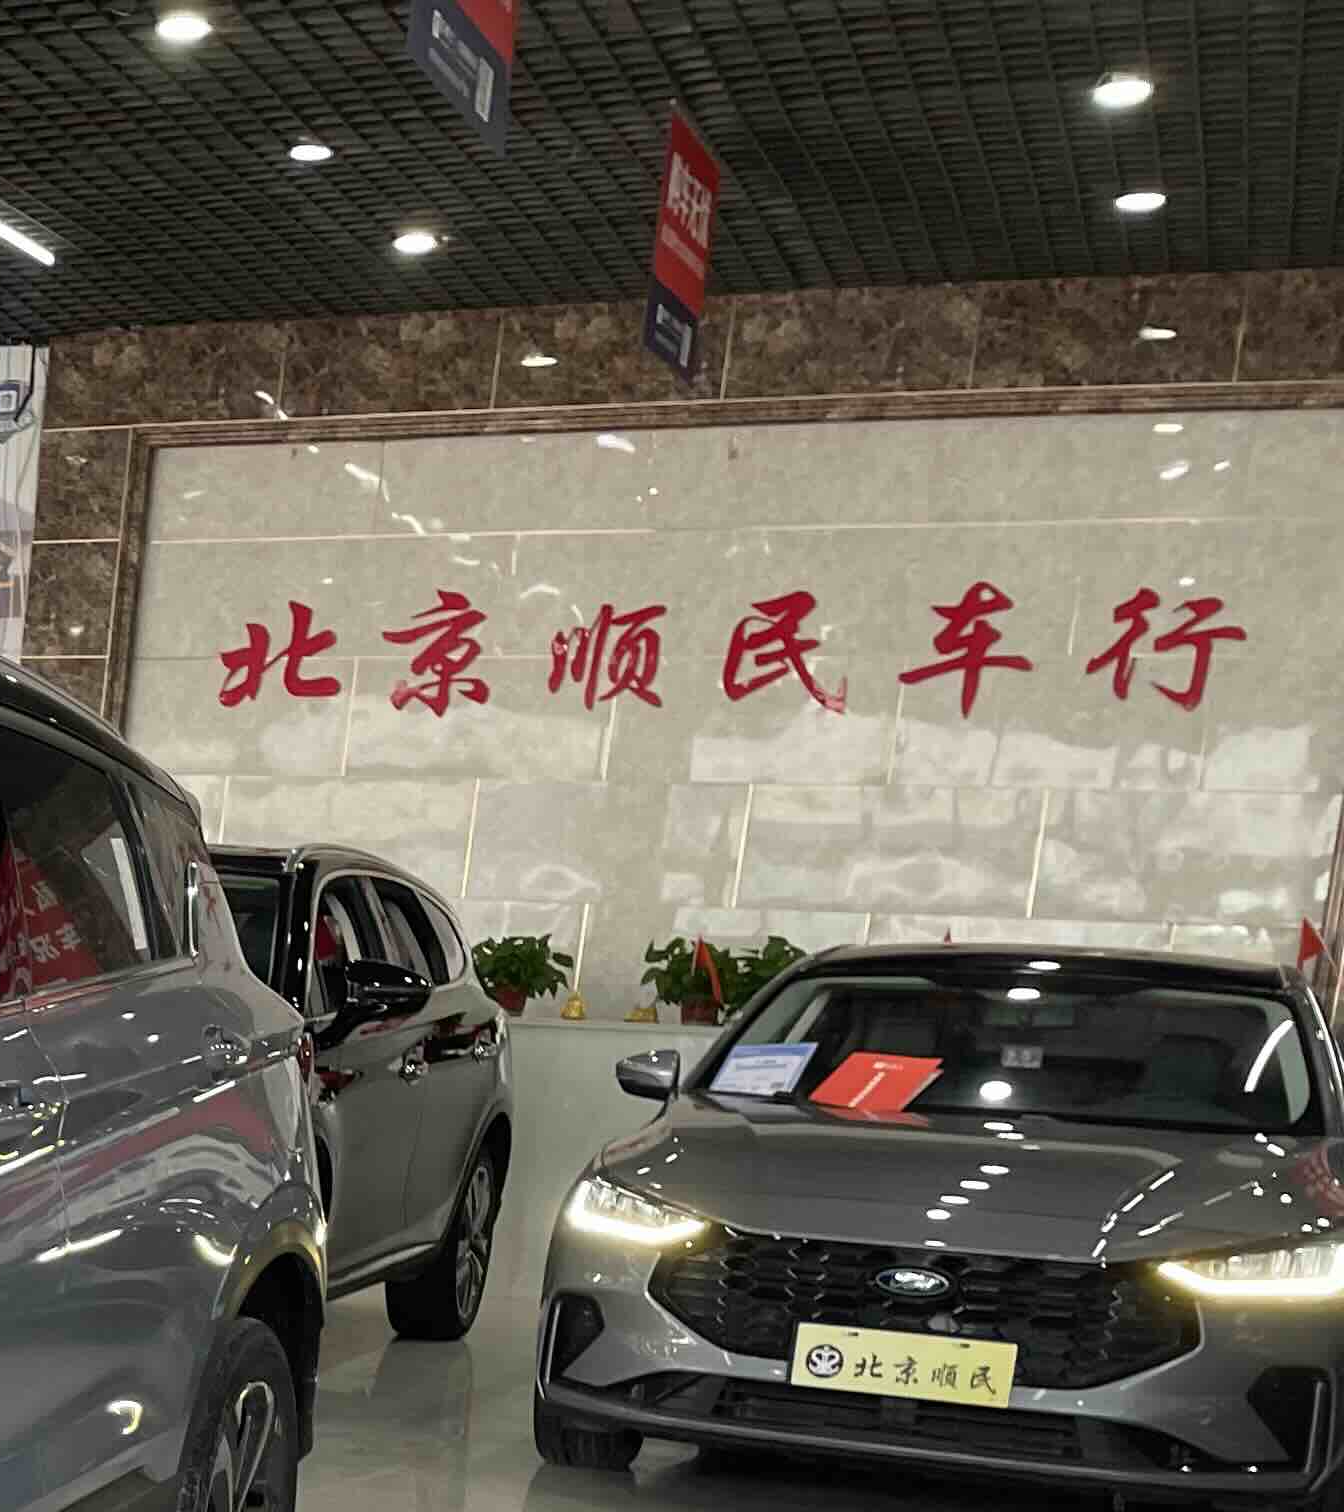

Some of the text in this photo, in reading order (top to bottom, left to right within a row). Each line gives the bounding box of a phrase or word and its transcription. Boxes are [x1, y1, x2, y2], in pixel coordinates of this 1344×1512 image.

[217, 579, 1249, 719] 北京顺民车行
[853, 1353, 997, 1395] 北京顺民
